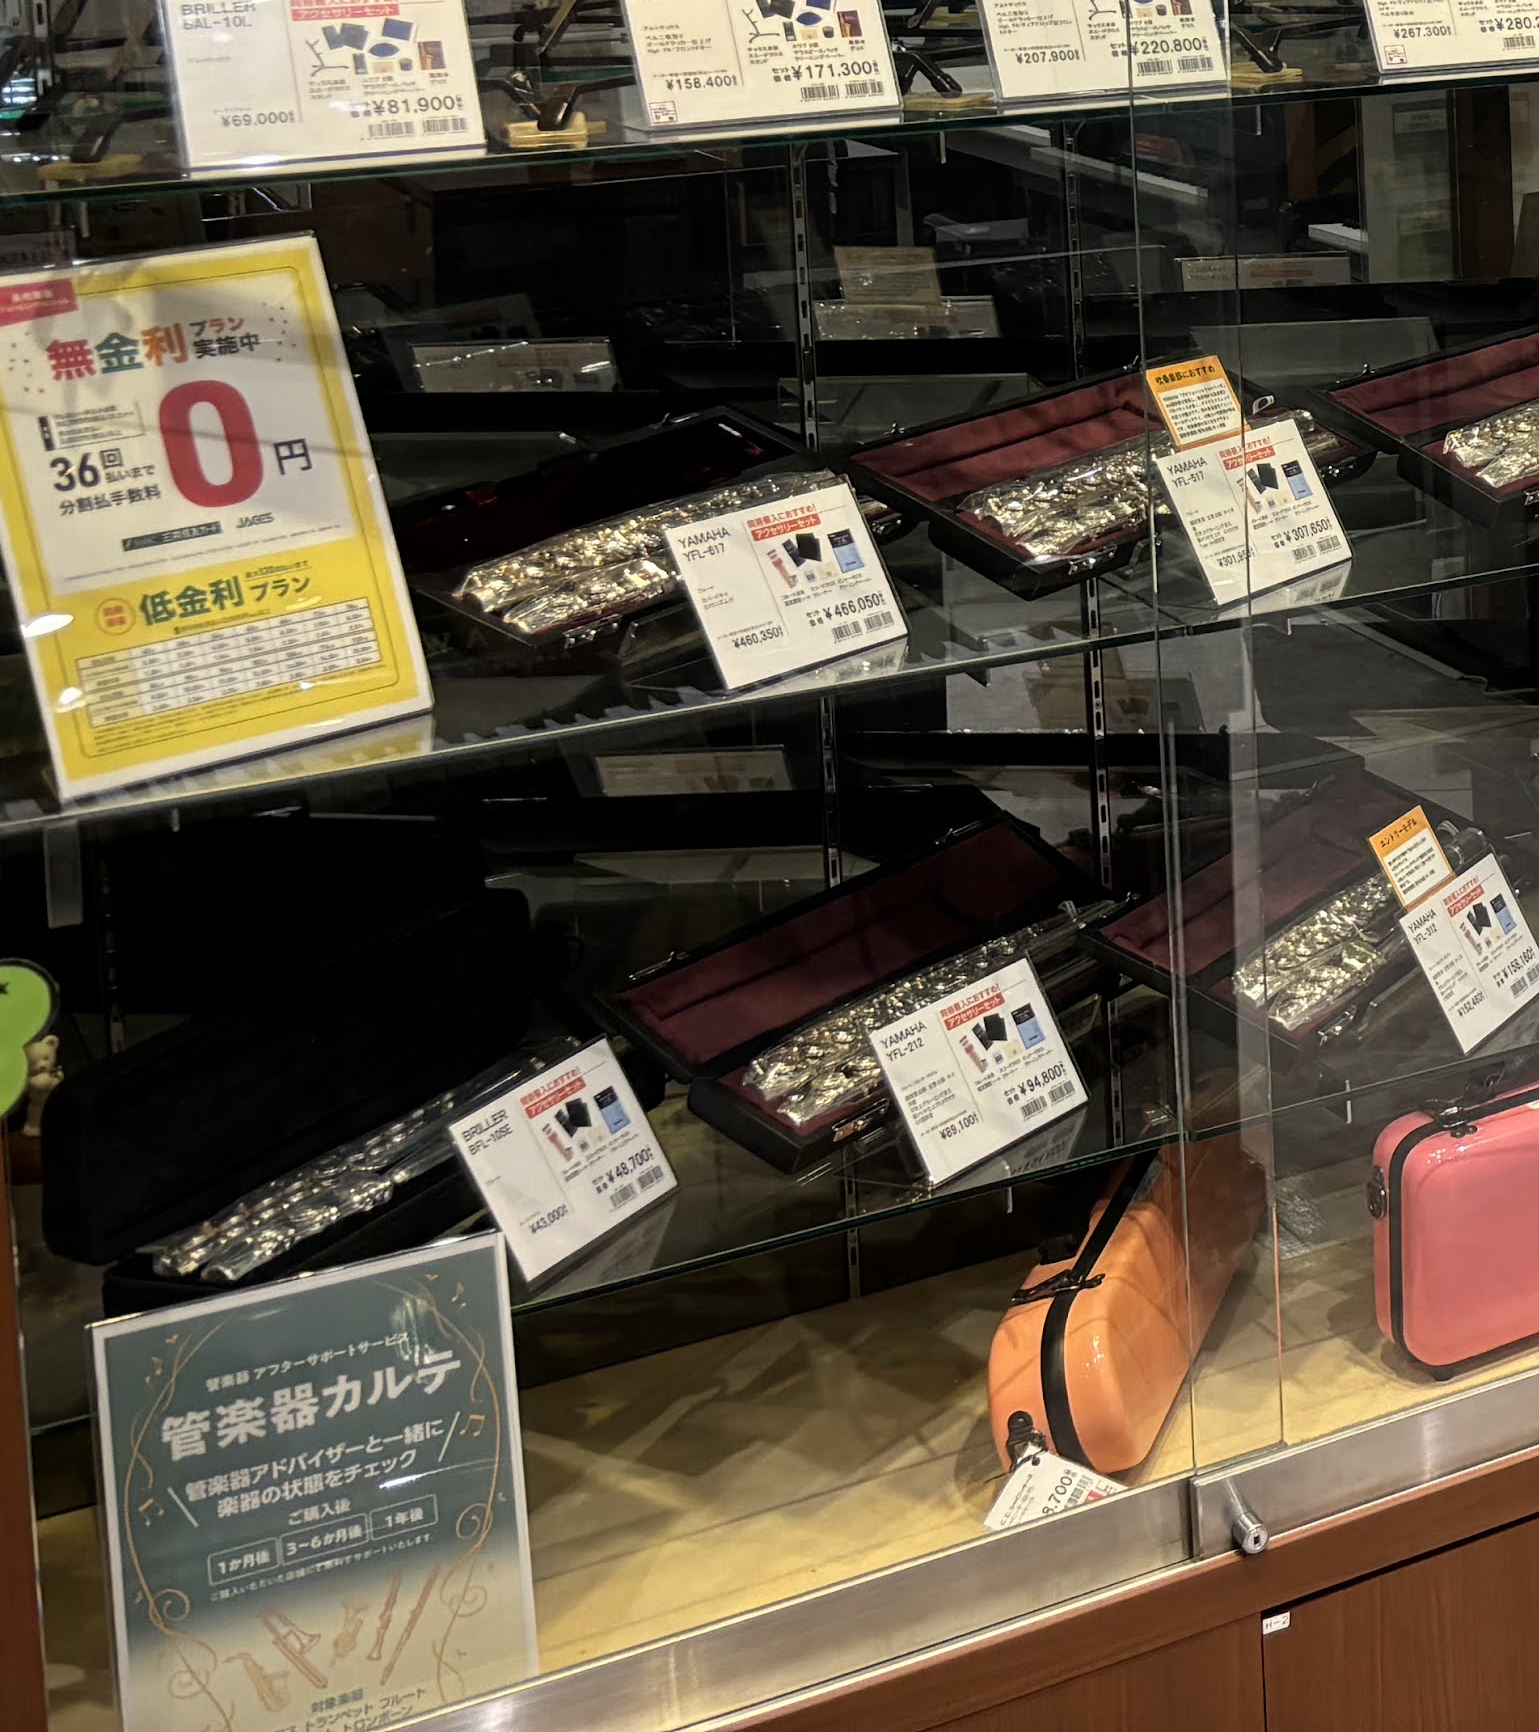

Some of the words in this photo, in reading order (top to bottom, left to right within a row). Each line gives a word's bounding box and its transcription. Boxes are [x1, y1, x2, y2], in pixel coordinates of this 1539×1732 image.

[298, 6, 394, 20] アクセサリーセット
[792, 61, 874, 81] ¥171,300
[373, 95, 456, 115] ¥81,900
[45, 322, 189, 381] 無金利
[189, 316, 245, 337] プラン
[194, 331, 260, 359] 実施中
[158, 380, 264, 508] 0
[274, 438, 313, 475] 円
[49, 452, 99, 492] 36
[100, 448, 123, 468] 回
[105, 464, 155, 483] 払いまで
[1166, 457, 1208, 476] YAMAHA
[59, 484, 162, 517] 分割払手数料
[677, 526, 730, 549] YAMAHA
[754, 516, 817, 540] アクセサリーセット
[138, 576, 244, 626] 低金利
[249, 576, 311, 602] プラン
[823, 593, 880, 619] ¥466,050
[1407, 909, 1437, 934] YAMAHA
[947, 995, 1003, 1029] アクセサリーセット
[880, 1021, 927, 1049] YAMAHA
[885, 1039, 924, 1061] YFL-212
[1017, 1064, 1062, 1096] ¥94,800
[461, 1110, 509, 1141] BRILLER
[206, 1370, 249, 1393] 管楽器
[253, 1331, 410, 1381] アフターサポートサービス
[161, 1349, 462, 1461] 管楽器カルテ
[184, 1419, 444, 1503] 管楽器アドバイザーと一緒に
[217, 1449, 417, 1519] 楽器の状態をチェック
[287, 1500, 351, 1526] ご購入後
[217, 1550, 271, 1575] 1か月後
[384, 1507, 424, 1528] 1年後
[380, 1687, 426, 1708] フルート
